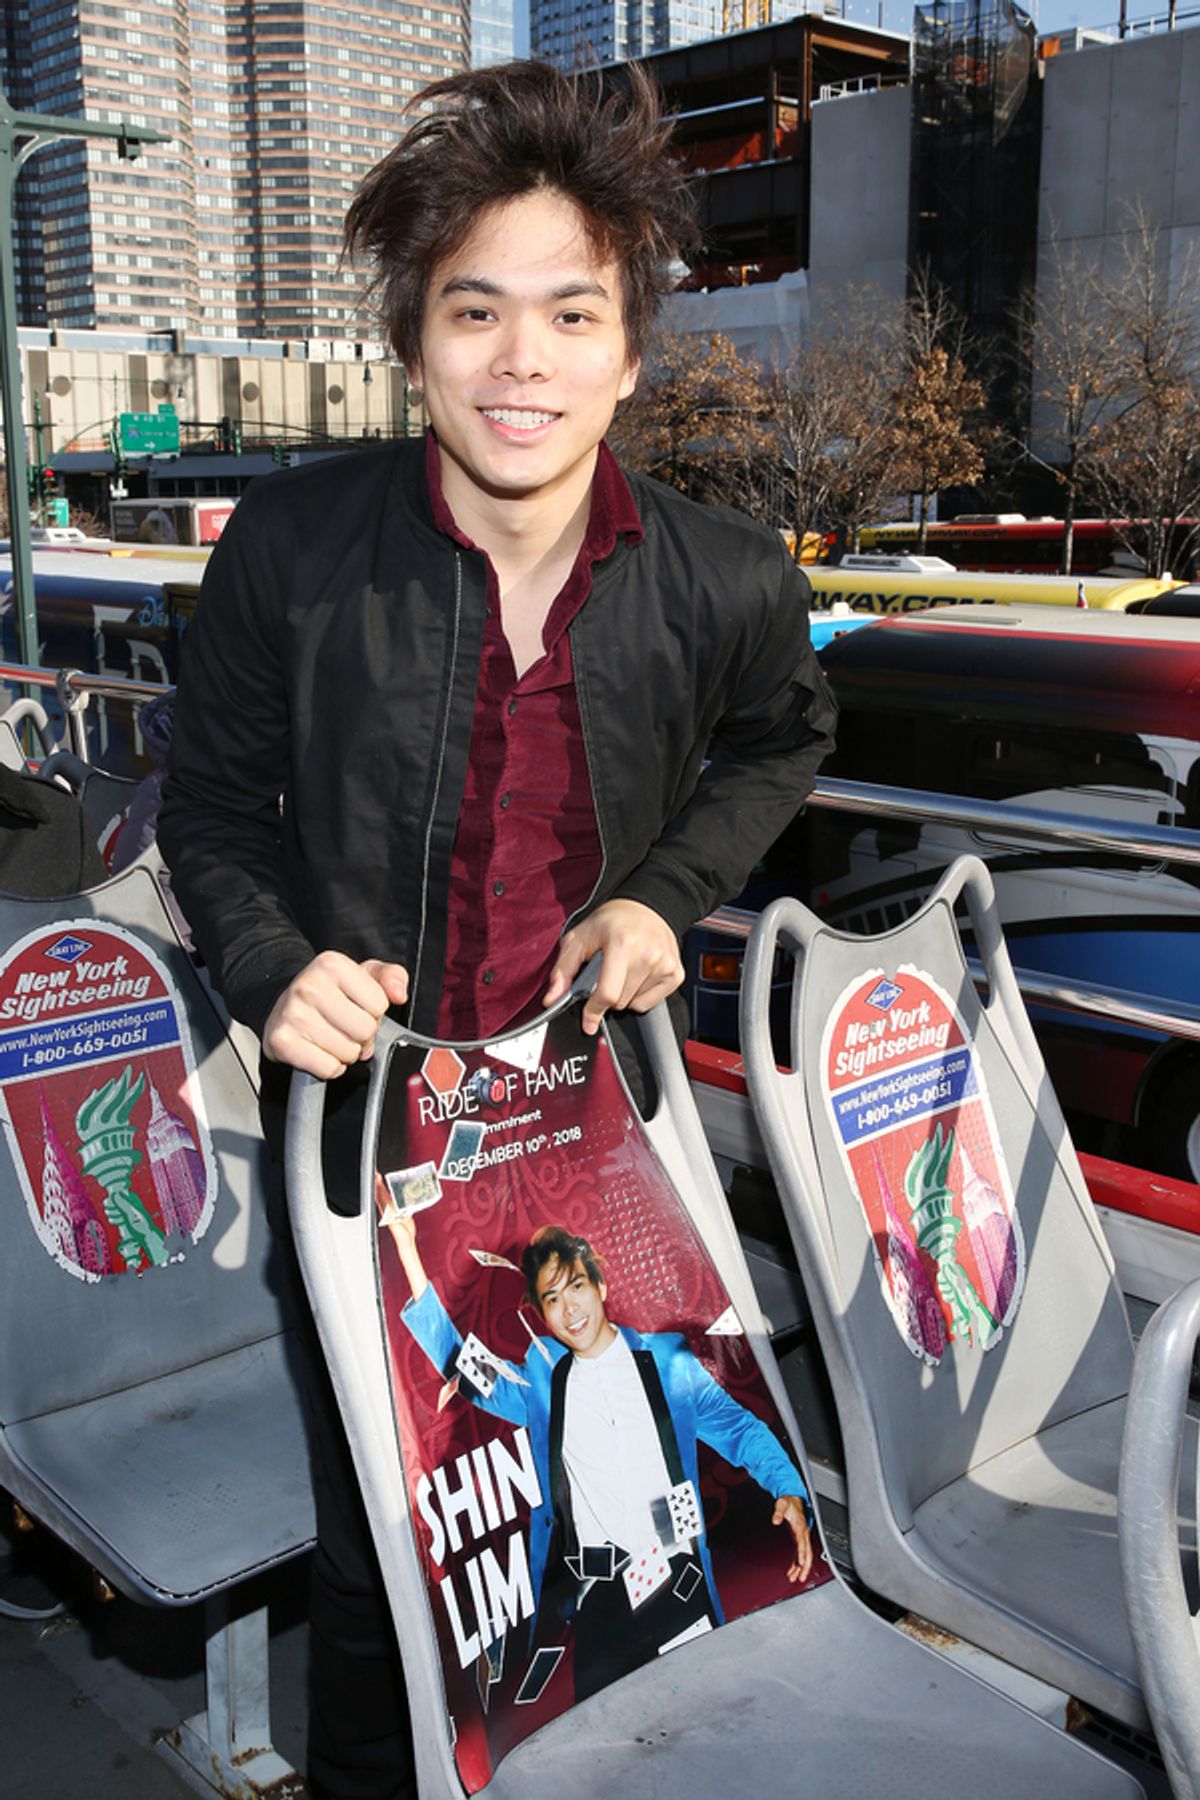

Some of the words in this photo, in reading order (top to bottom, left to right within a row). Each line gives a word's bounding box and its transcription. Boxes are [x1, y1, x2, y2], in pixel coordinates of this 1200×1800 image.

[0, 976, 150, 1020] Sightseeing
[14, 969, 71, 995] New
[75, 955, 129, 983] York
[22, 1028, 148, 1067] 1-800-669-0051
[845, 1018, 888, 1048] New
[889, 1000, 930, 1032] York
[835, 1022, 950, 1076] Sightseeing
[418, 1085, 480, 1126] RIDE
[857, 1081, 951, 1129] 1-800-669-0051
[447, 1142, 524, 1178] DECEMBER
[552, 1126, 583, 1146] 2018
[416, 1426, 544, 1567] SHIN
[440, 1530, 536, 1670] LIM
